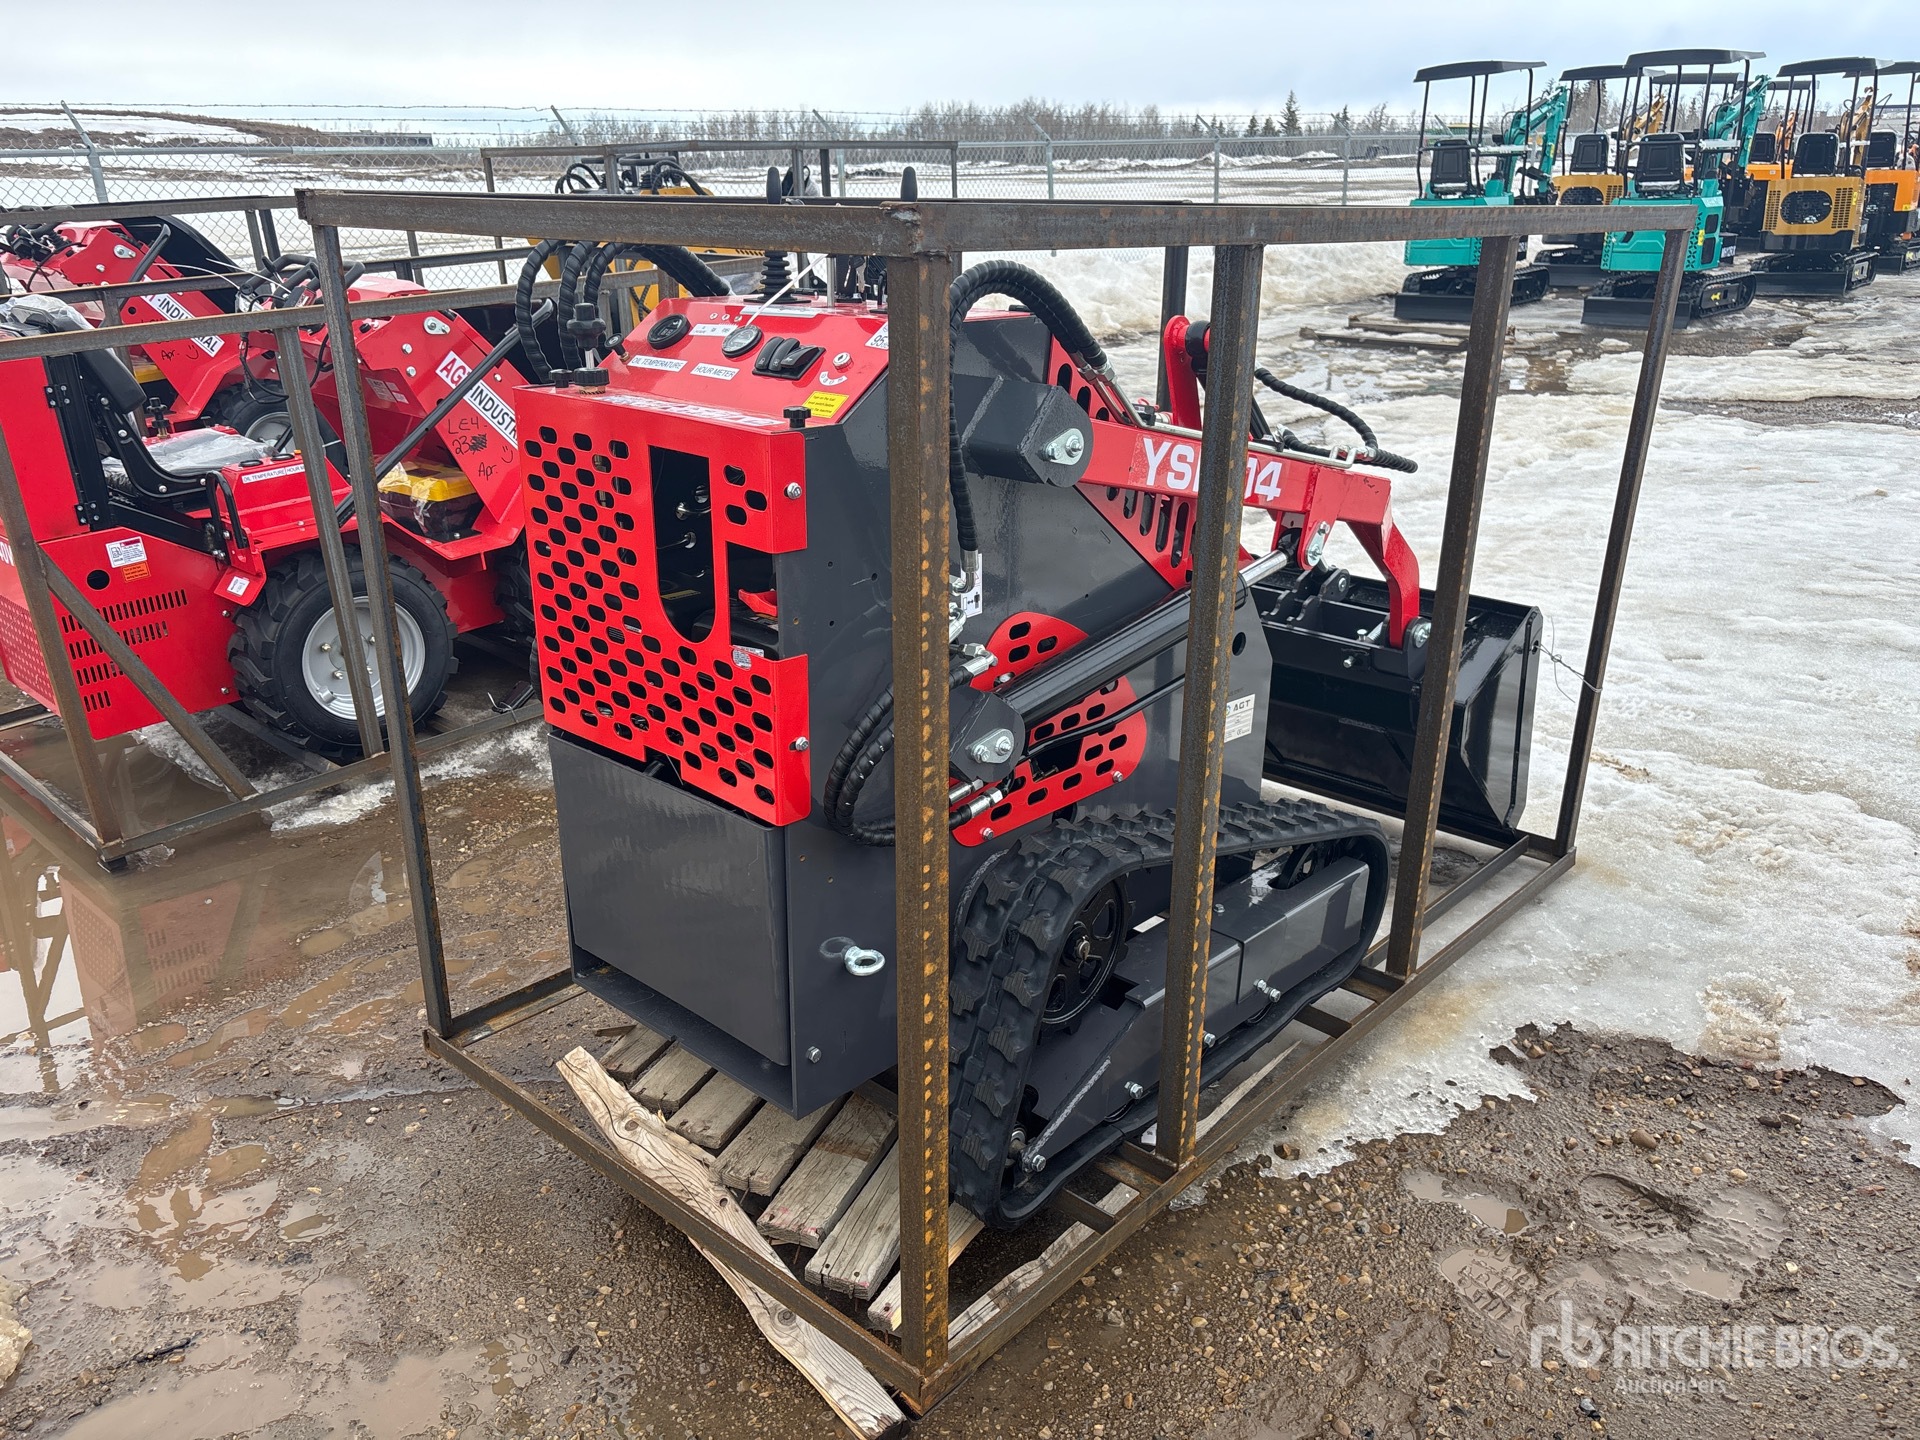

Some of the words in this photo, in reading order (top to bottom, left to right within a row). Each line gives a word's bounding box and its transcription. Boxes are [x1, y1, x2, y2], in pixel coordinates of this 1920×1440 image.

[643, 358, 684, 370] TEMPERATURE
[694, 365, 713, 375] HOUR
[713, 368, 736, 378] METER
[252, 469, 286, 480] TEMPERATURE
[1233, 699, 1251, 712] AGT
